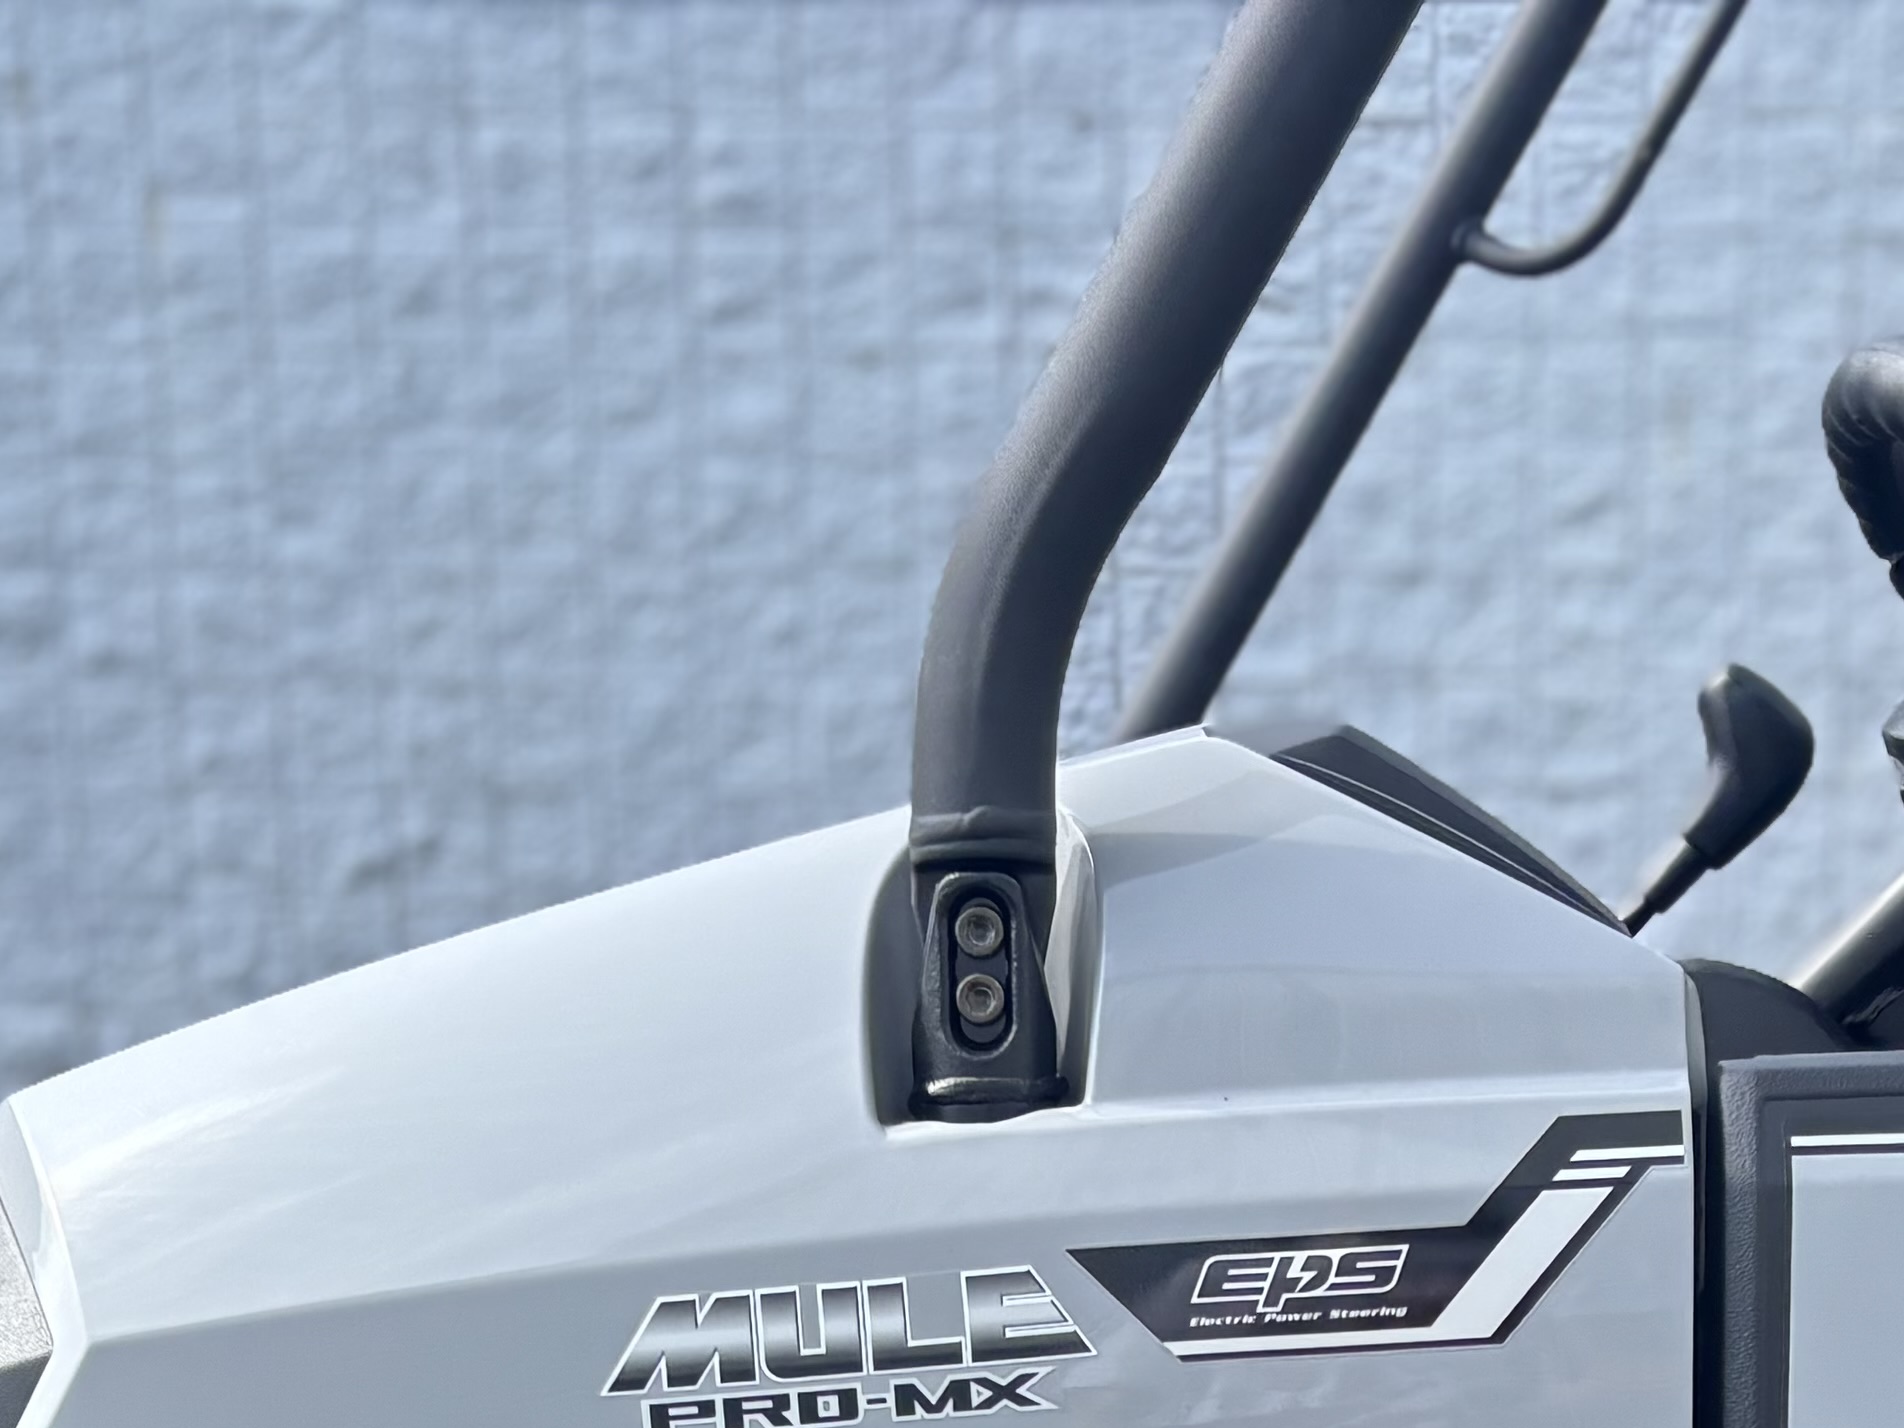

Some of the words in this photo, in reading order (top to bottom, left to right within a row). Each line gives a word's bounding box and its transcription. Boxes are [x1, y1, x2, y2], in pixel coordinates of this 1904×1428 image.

[1190, 1244, 1410, 1313] EPS
[600, 1265, 1096, 1396] MULE
[1189, 1313, 1257, 1327] Electric
[1264, 1310, 1323, 1324] Power
[1329, 1305, 1408, 1320] Steering
